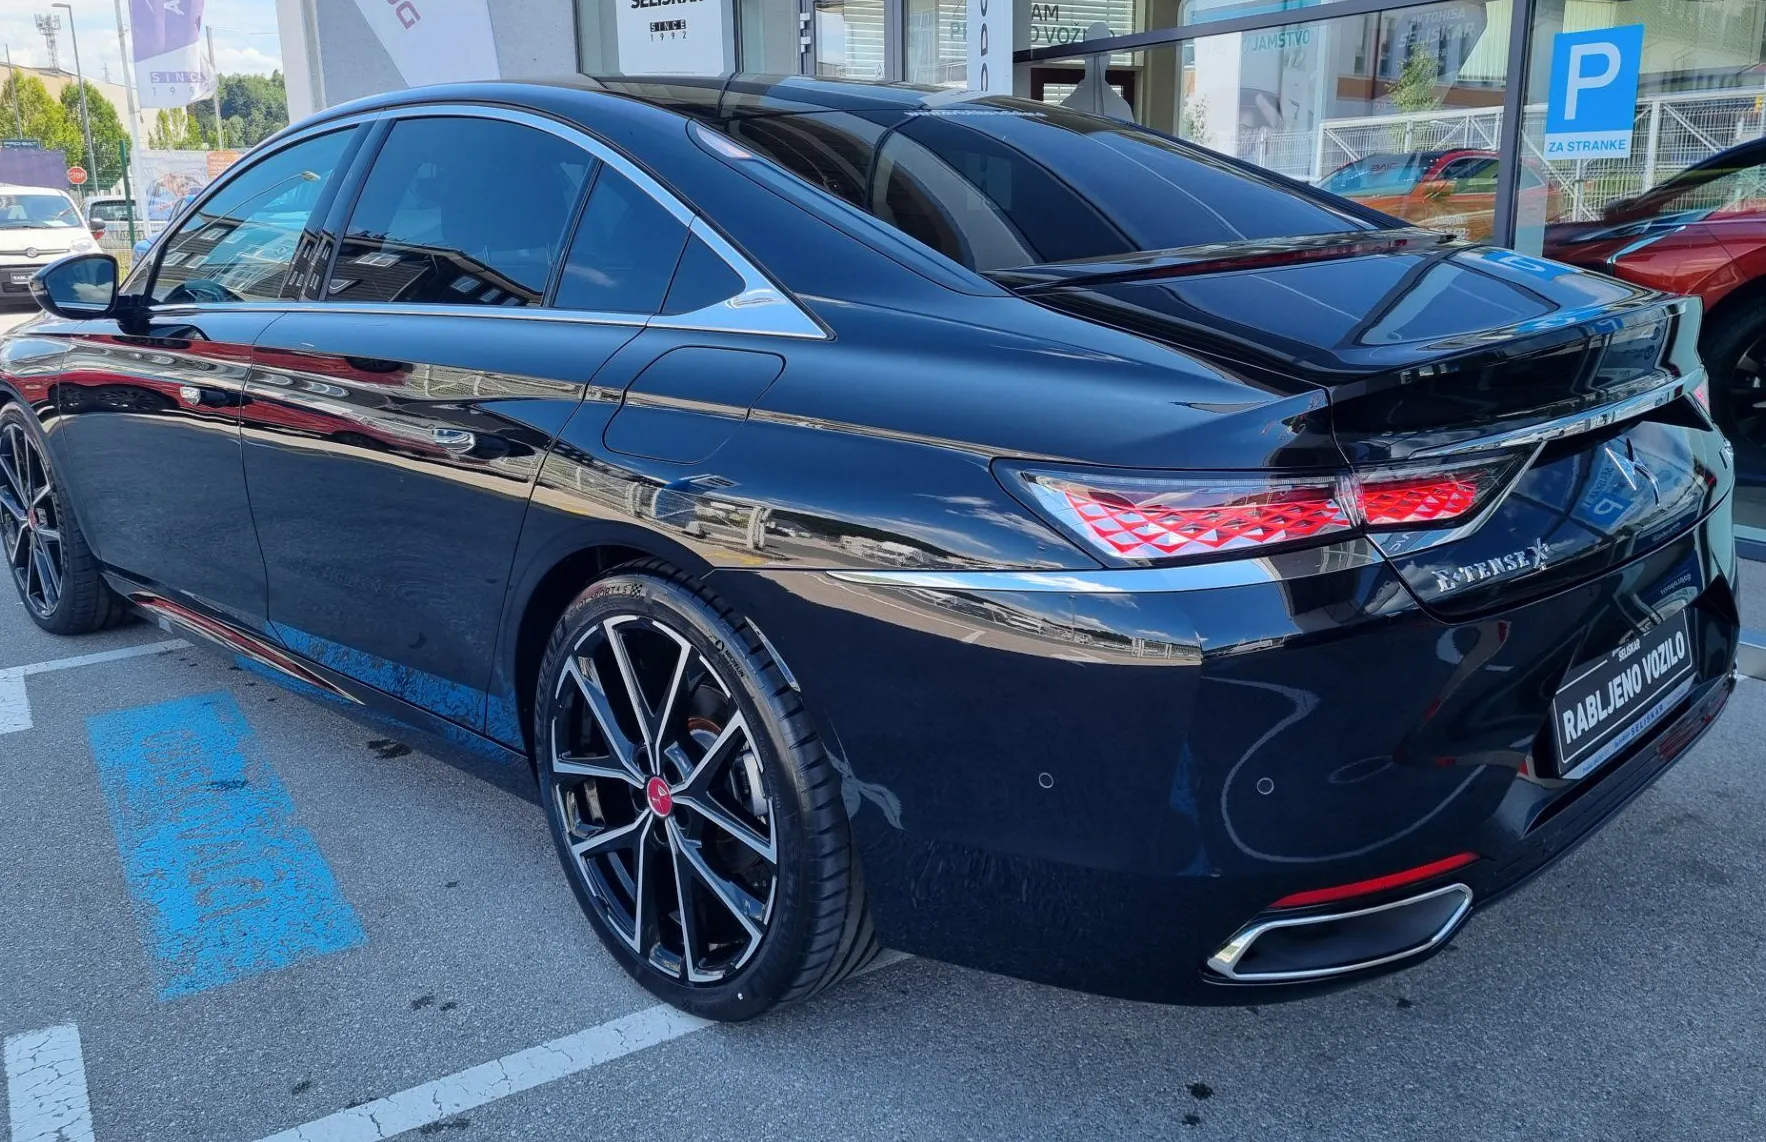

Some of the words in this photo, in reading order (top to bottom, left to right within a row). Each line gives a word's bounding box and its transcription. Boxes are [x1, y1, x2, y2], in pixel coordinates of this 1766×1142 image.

[651, 20, 686, 32] SINCE
[650, 31, 687, 41] 1992
[1253, 29, 1310, 51] JAMSTVO
[1564, 42, 1621, 120] P
[1549, 142, 1563, 152] ZA
[1567, 139, 1626, 151] STRANKE
[69, 171, 85, 179] STOP
[724, 649, 745, 678] MICHELIN
[1563, 664, 1642, 744] RABLJENO
[1642, 631, 1685, 684] VOZILO
